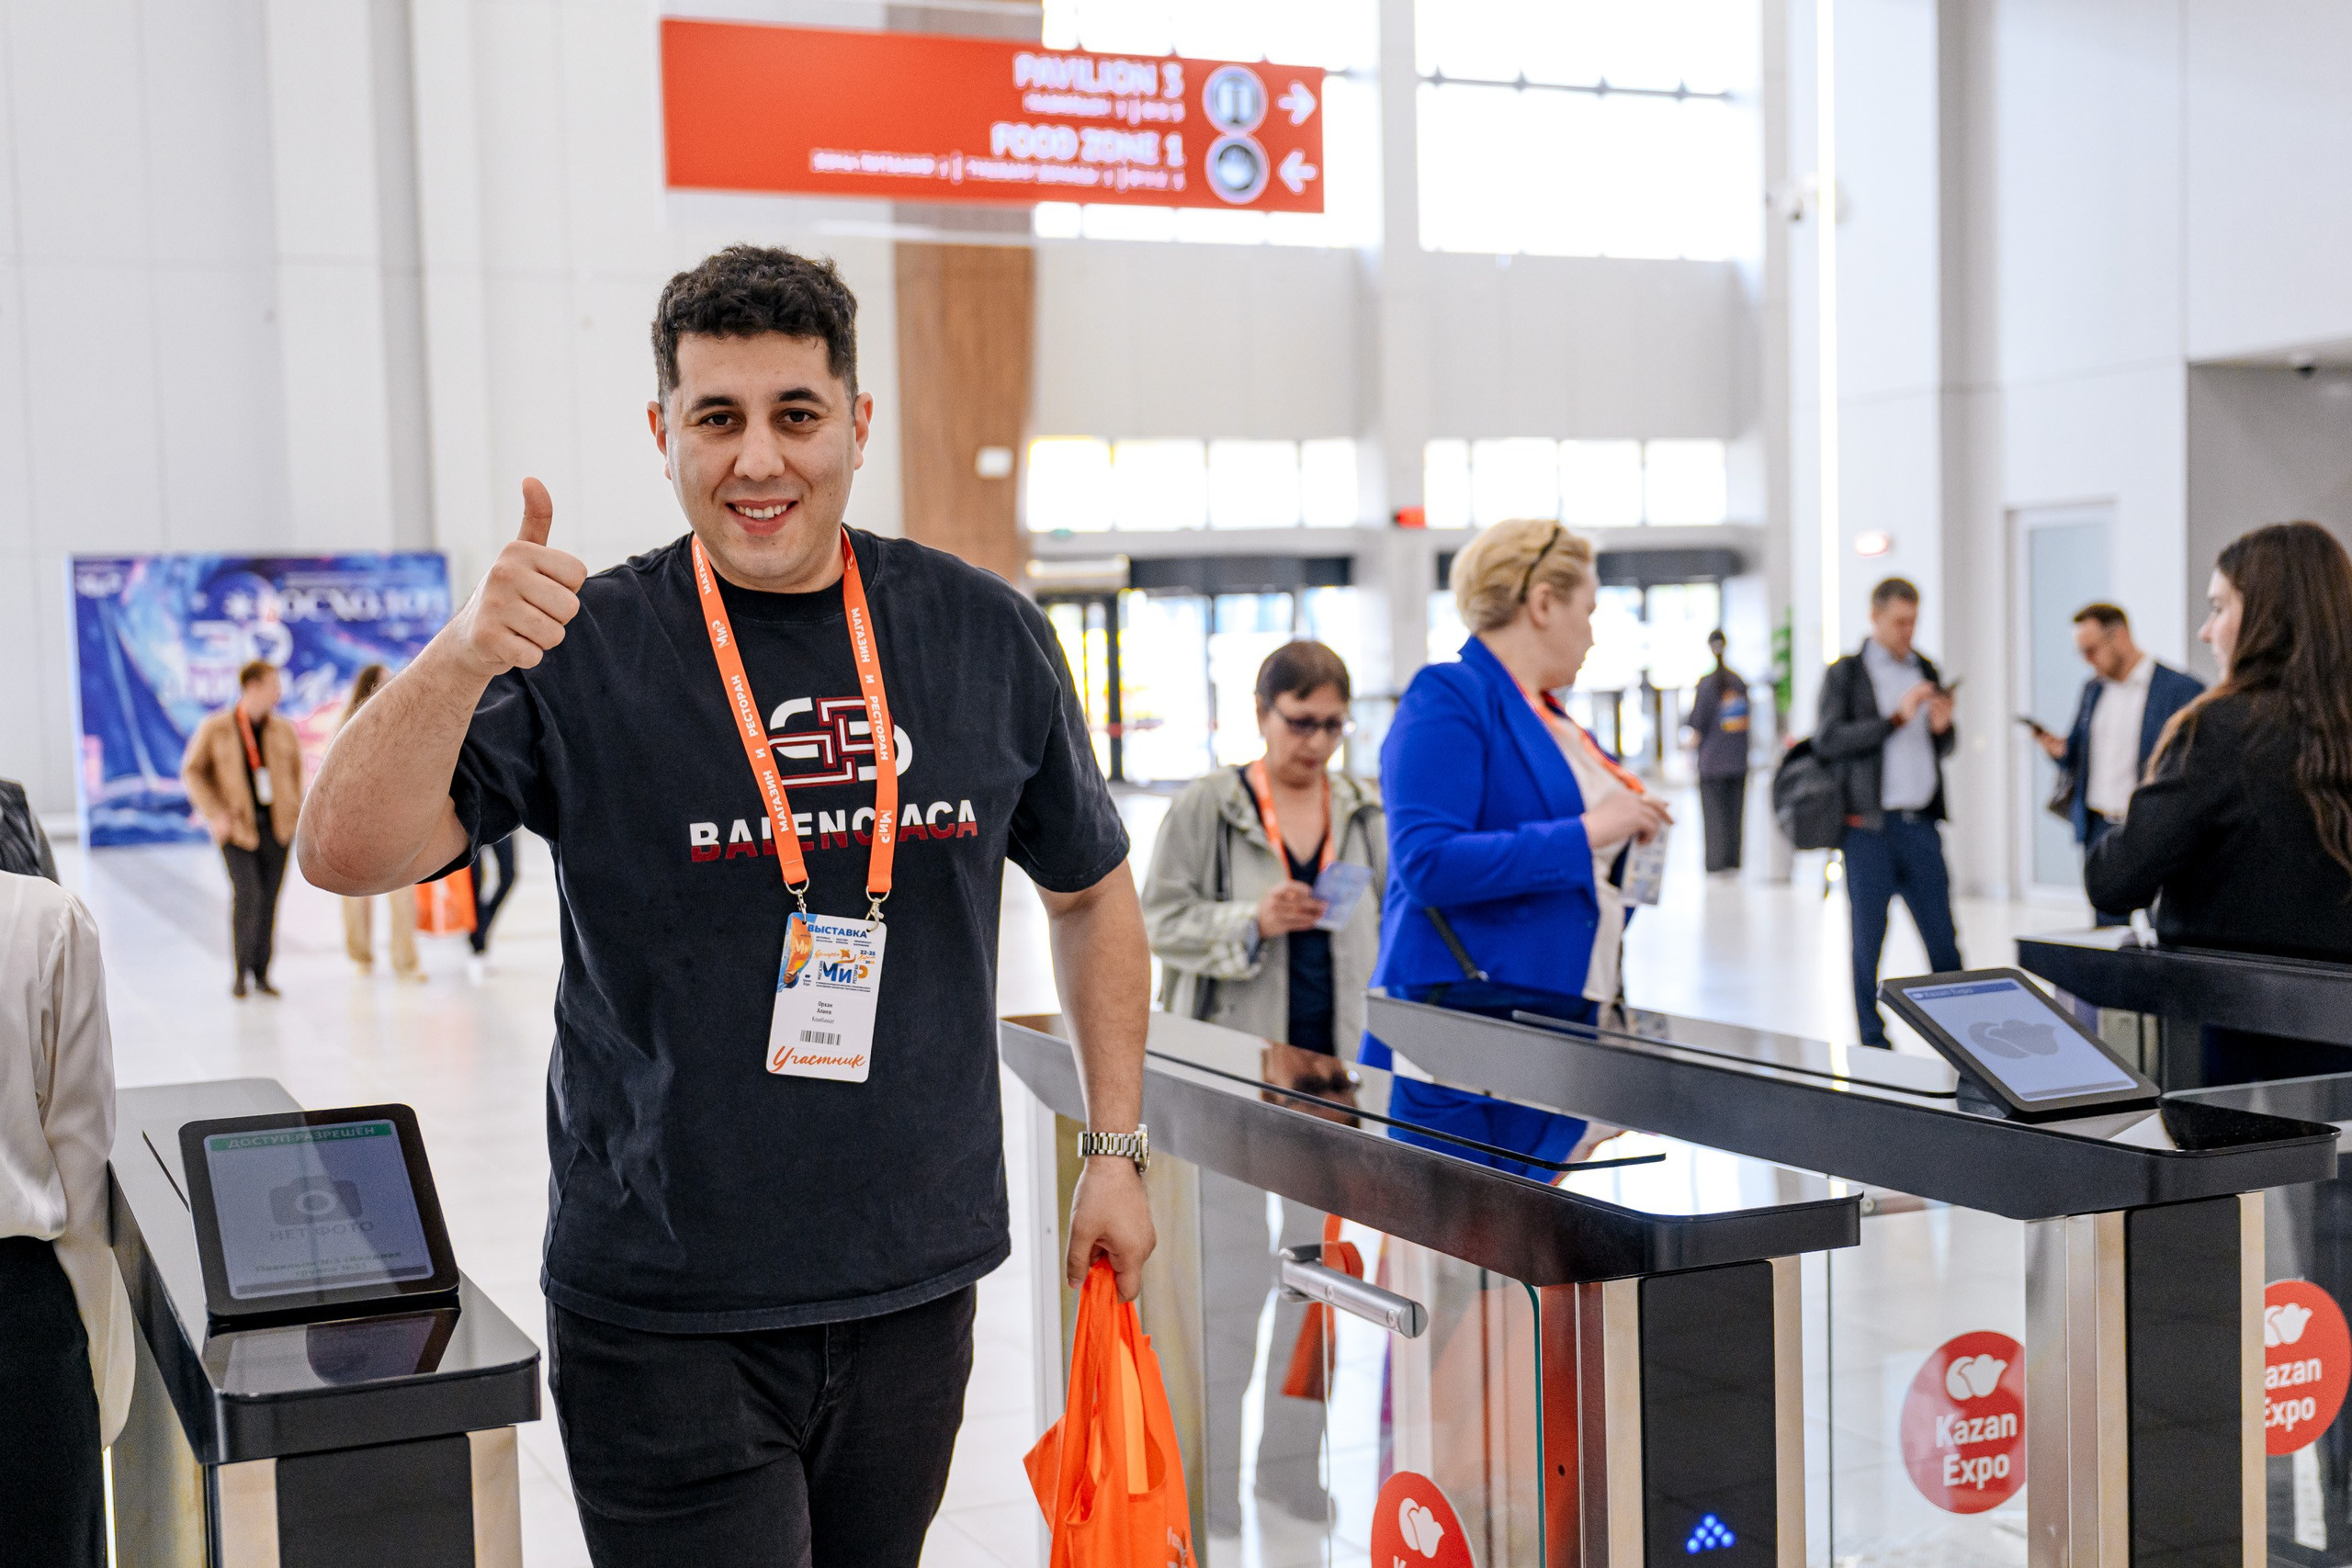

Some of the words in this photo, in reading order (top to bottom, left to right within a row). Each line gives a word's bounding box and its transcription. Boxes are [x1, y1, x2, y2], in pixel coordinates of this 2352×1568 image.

[1014, 53, 1158, 96] PAVILION
[992, 122, 1079, 159] FOOD
[1080, 128, 1159, 165] ZONE
[851, 606, 871, 664] МАГАЗИН
[865, 673, 876, 684] И
[731, 674, 759, 738] РЕСТОРАН
[869, 694, 889, 761] РЕСТОРАН
[754, 747, 766, 760] И
[763, 770, 790, 833] МАГАЗИН
[807, 924, 868, 939] ВЫСТАВКА
[769, 1045, 866, 1073] Участник
[226, 1134, 290, 1150] ДОСТУП
[295, 1125, 376, 1145] РАЗРЕШЕН
[269, 1227, 307, 1242] НЕТ
[314, 1221, 375, 1237] ФОТО
[2265, 1358, 2323, 1390] azan
[1935, 1412, 2018, 1448] Kazan
[1943, 1453, 2010, 1491] Expo
